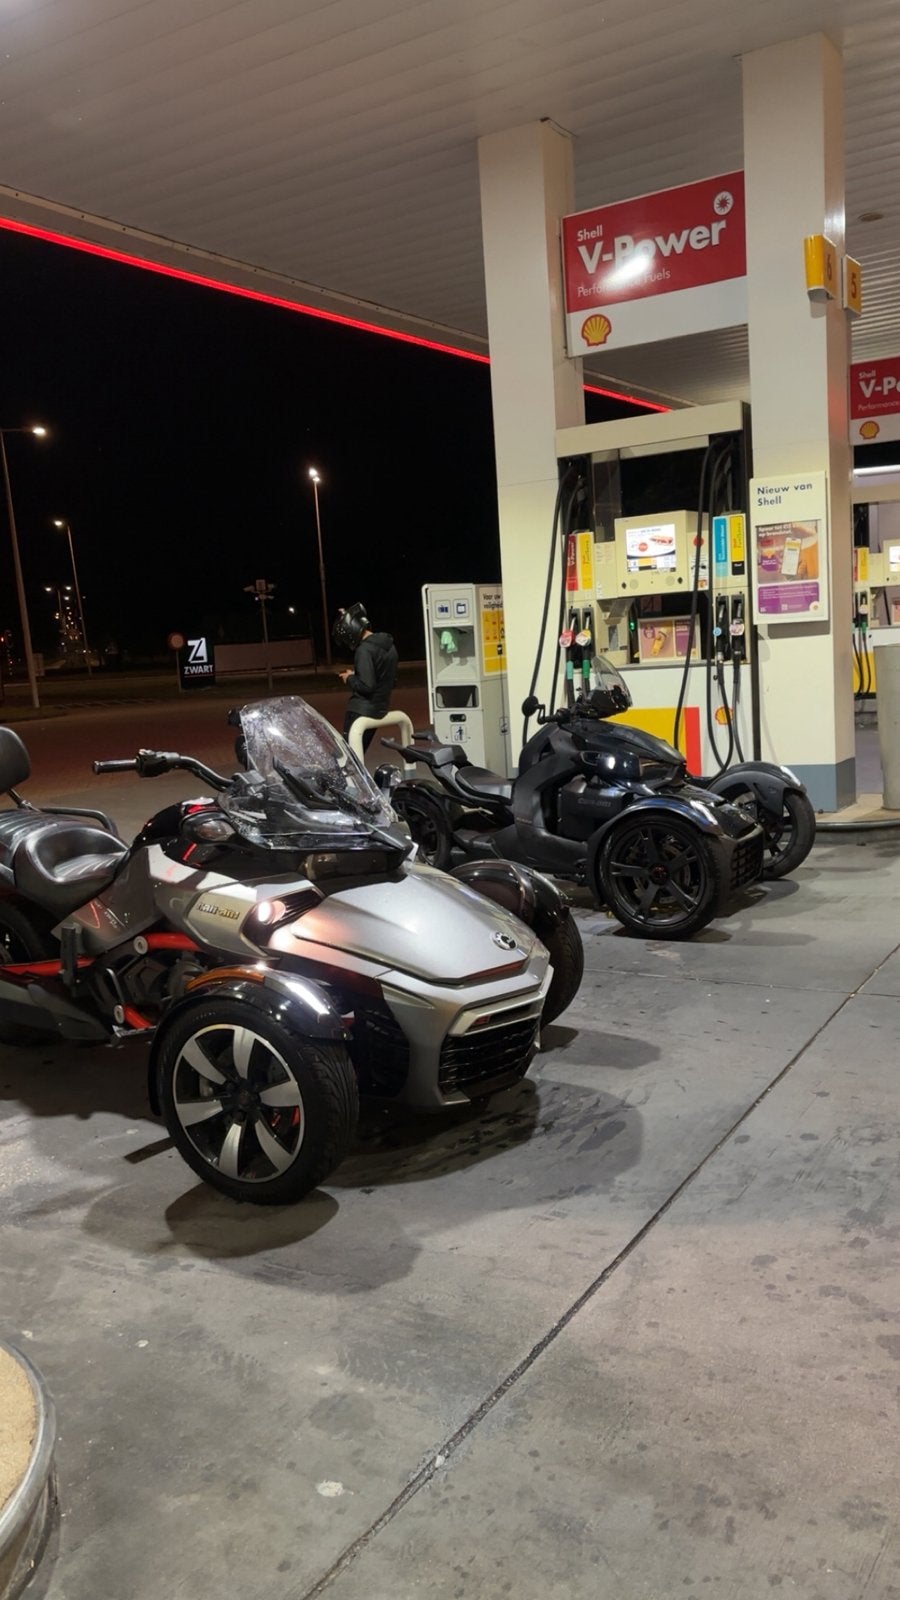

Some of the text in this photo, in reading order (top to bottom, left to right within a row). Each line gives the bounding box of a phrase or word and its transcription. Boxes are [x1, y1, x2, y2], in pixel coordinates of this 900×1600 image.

[577, 225, 603, 242] Shell
[577, 220, 727, 274] V-Power
[826, 254, 833, 281] 6
[645, 268, 671, 284] Fuels
[851, 272, 857, 299] 5
[858, 370, 876, 379] Shell
[757, 482, 813, 495] Nieuw van
[757, 496, 782, 506] Shell
[184, 664, 213, 675] ZWART
